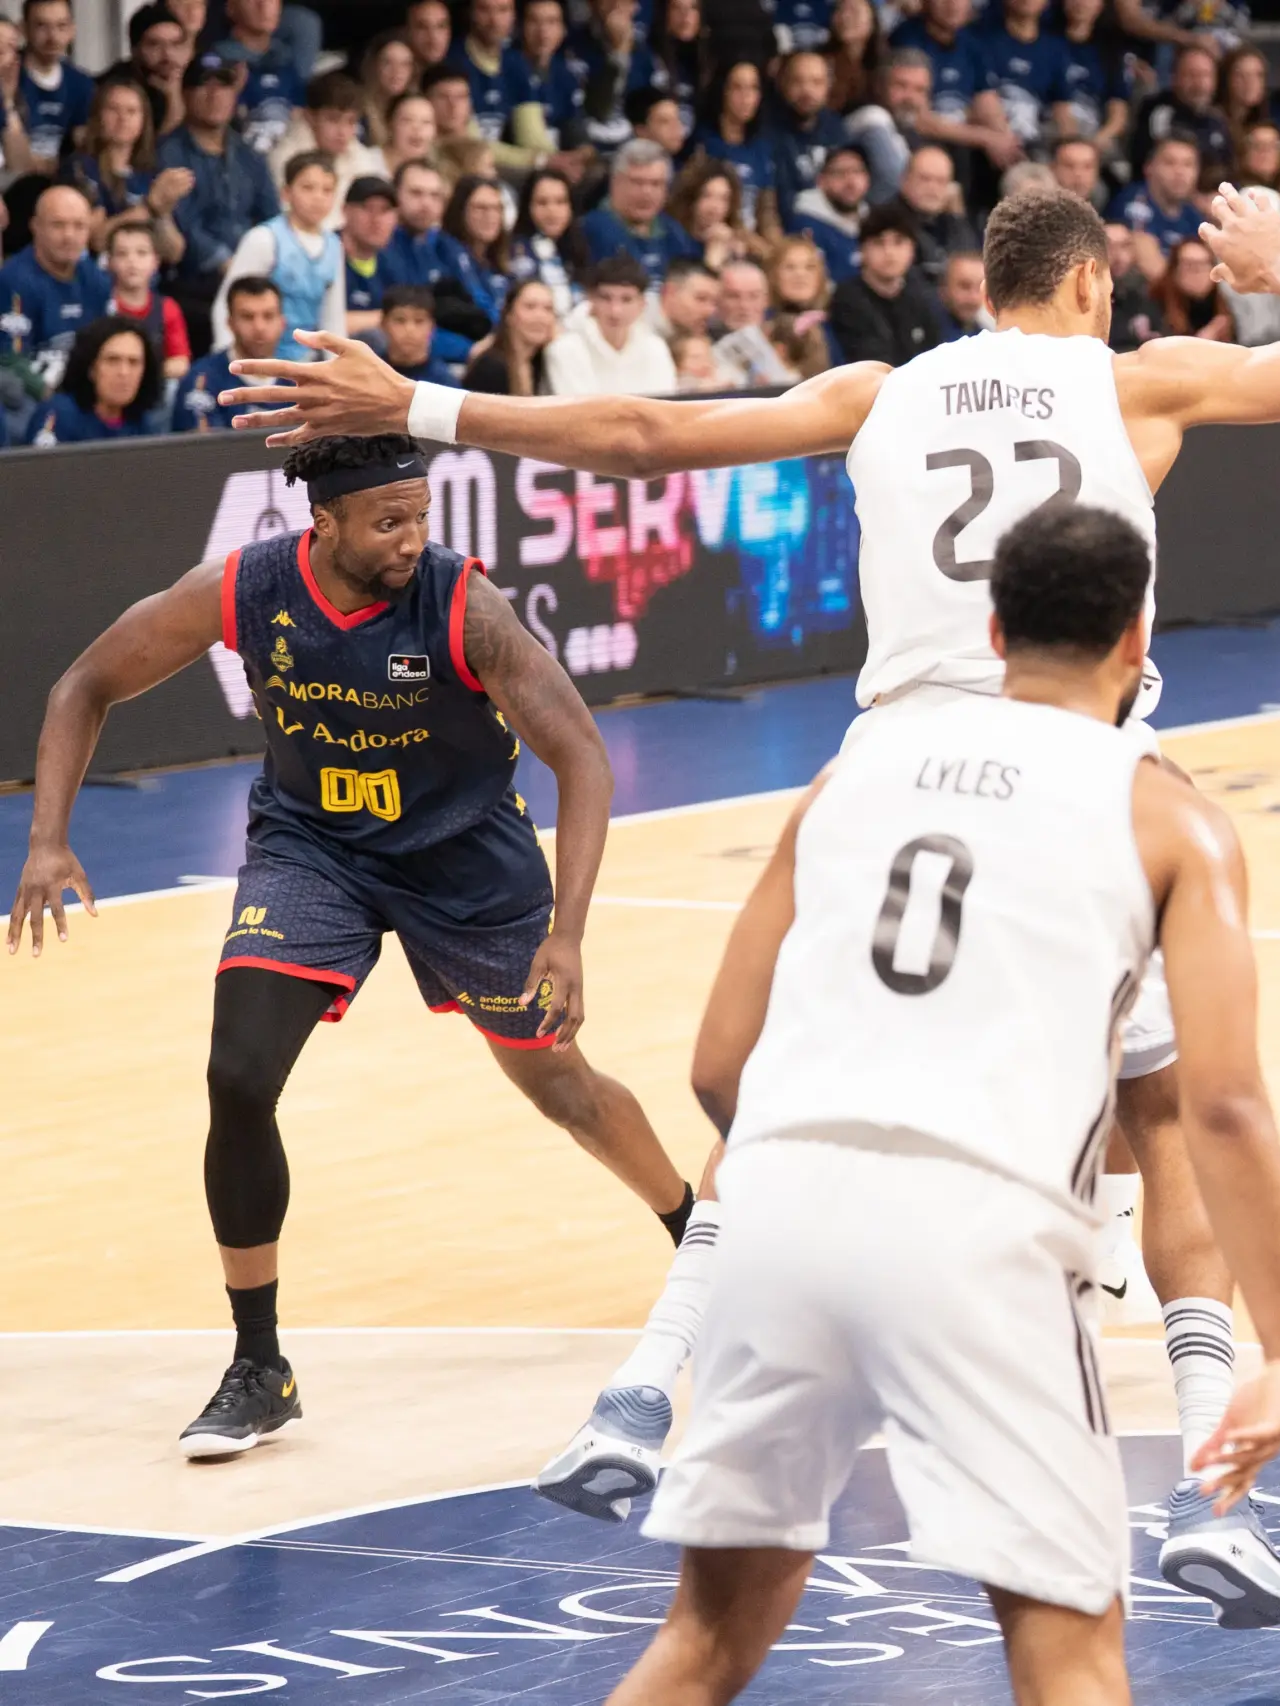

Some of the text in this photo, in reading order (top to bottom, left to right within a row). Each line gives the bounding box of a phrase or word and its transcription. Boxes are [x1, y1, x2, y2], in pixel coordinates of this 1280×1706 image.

[939, 379, 1055, 420] TAVARES
[427, 447, 498, 571] M
[392, 662, 408, 672] liga
[392, 670, 426, 678] endesa
[289, 680, 430, 710] MORABANC
[312, 722, 431, 752] Andorra
[319, 766, 402, 822] 00
[915, 757, 1021, 801] LYLES
[871, 833, 974, 997] 0
[480, 995, 521, 1005] andorr
[480, 1003, 529, 1013] telecom
